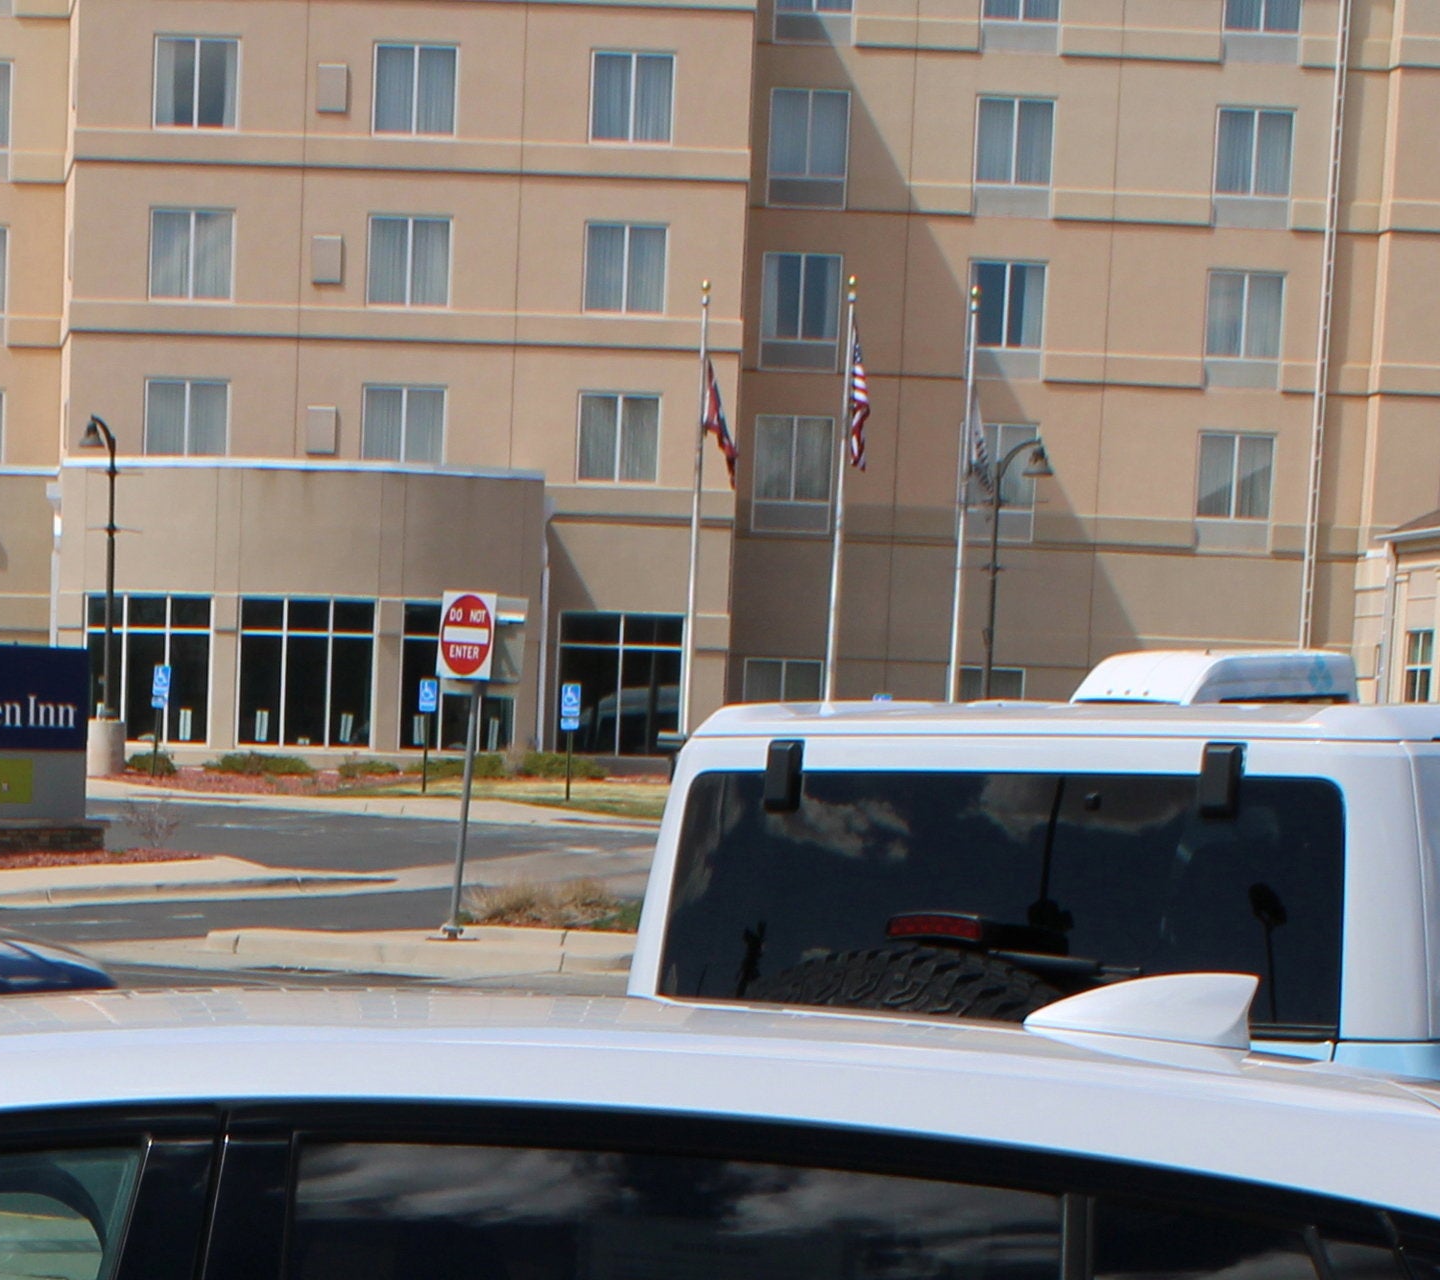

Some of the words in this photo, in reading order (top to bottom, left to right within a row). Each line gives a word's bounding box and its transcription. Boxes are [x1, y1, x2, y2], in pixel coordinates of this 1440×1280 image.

[449, 607, 463, 622] DO
[469, 609, 487, 623] NOT
[449, 644, 480, 660] ENTER
[28, 694, 77, 728] Inn
